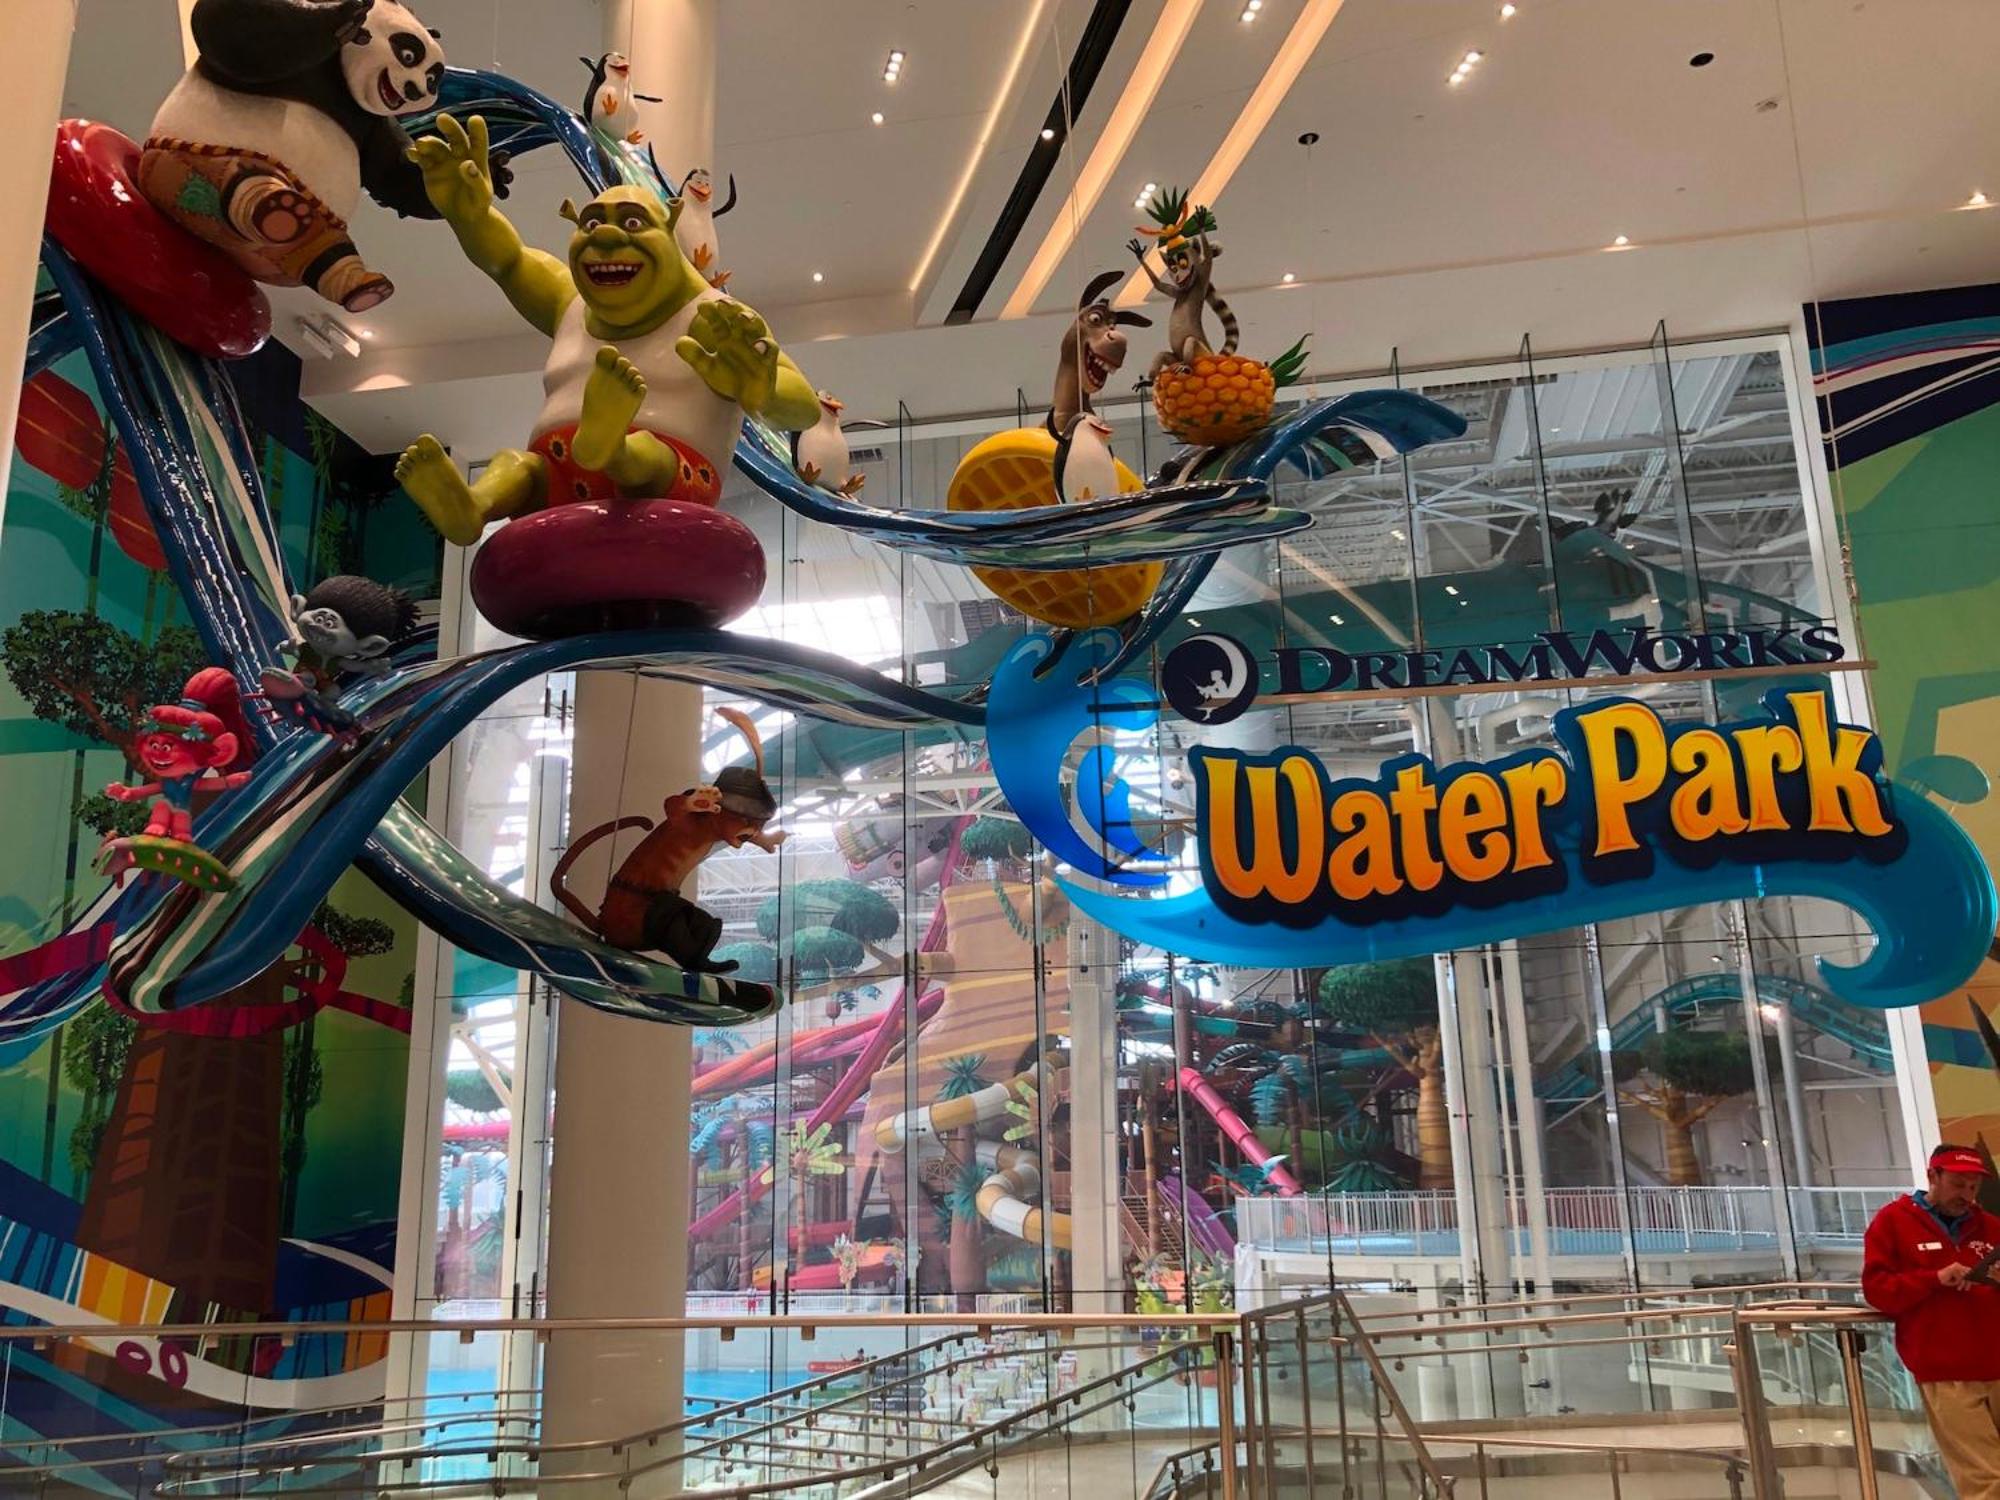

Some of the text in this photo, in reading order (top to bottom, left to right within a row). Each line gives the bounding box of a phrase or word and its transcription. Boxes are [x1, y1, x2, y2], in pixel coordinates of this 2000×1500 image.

[1271, 626, 1846, 695] DREAMWORKS
[1202, 690, 1894, 903] Water Park
